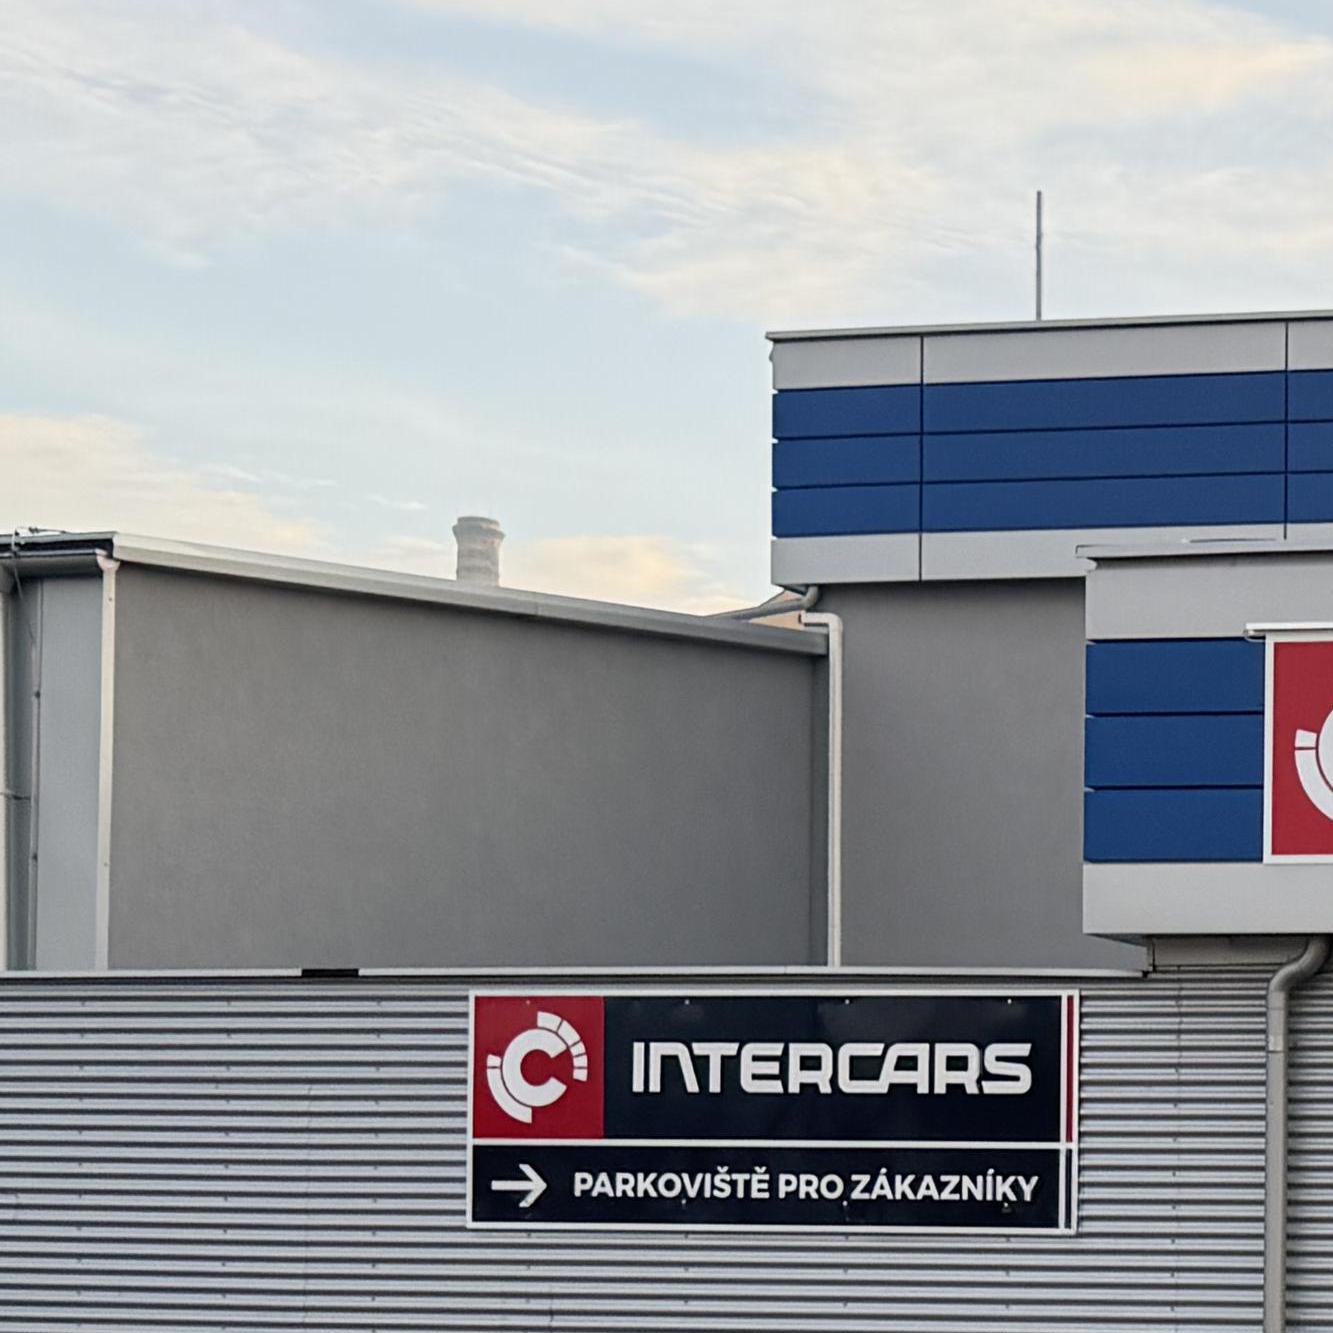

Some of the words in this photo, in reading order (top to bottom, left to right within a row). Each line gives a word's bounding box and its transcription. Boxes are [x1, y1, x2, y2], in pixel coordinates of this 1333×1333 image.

[632, 1042, 1033, 1095] INTERCARS
[573, 1166, 770, 1200] PARKOVIŠTĚ
[778, 1173, 844, 1200] PRO
[850, 1168, 1039, 1202] ZÁKAZNÍKY
